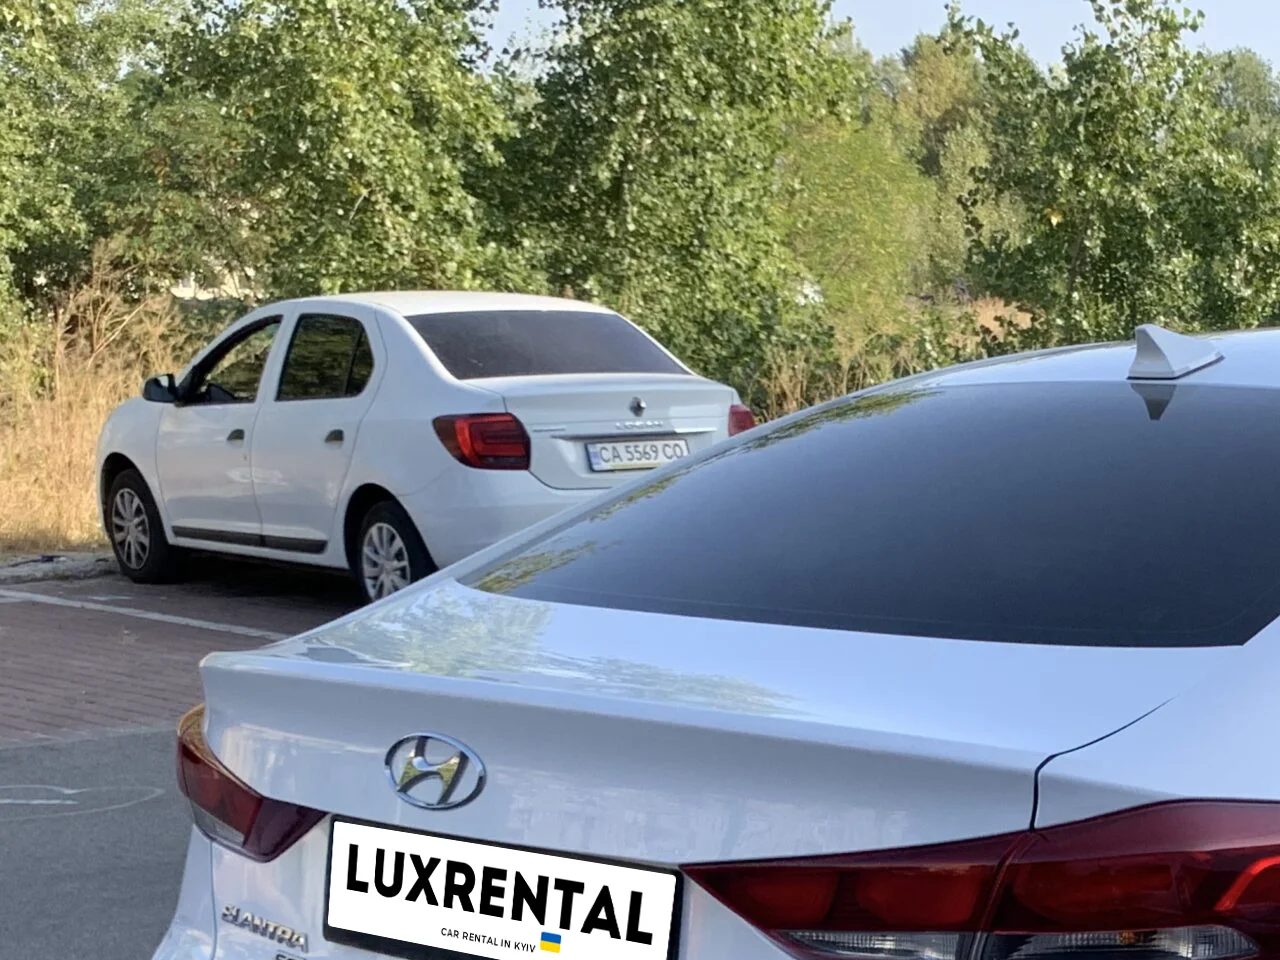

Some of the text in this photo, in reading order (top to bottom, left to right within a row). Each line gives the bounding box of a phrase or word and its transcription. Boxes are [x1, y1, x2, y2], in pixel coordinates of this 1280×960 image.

[600, 443, 684, 463] CA 5569 CO
